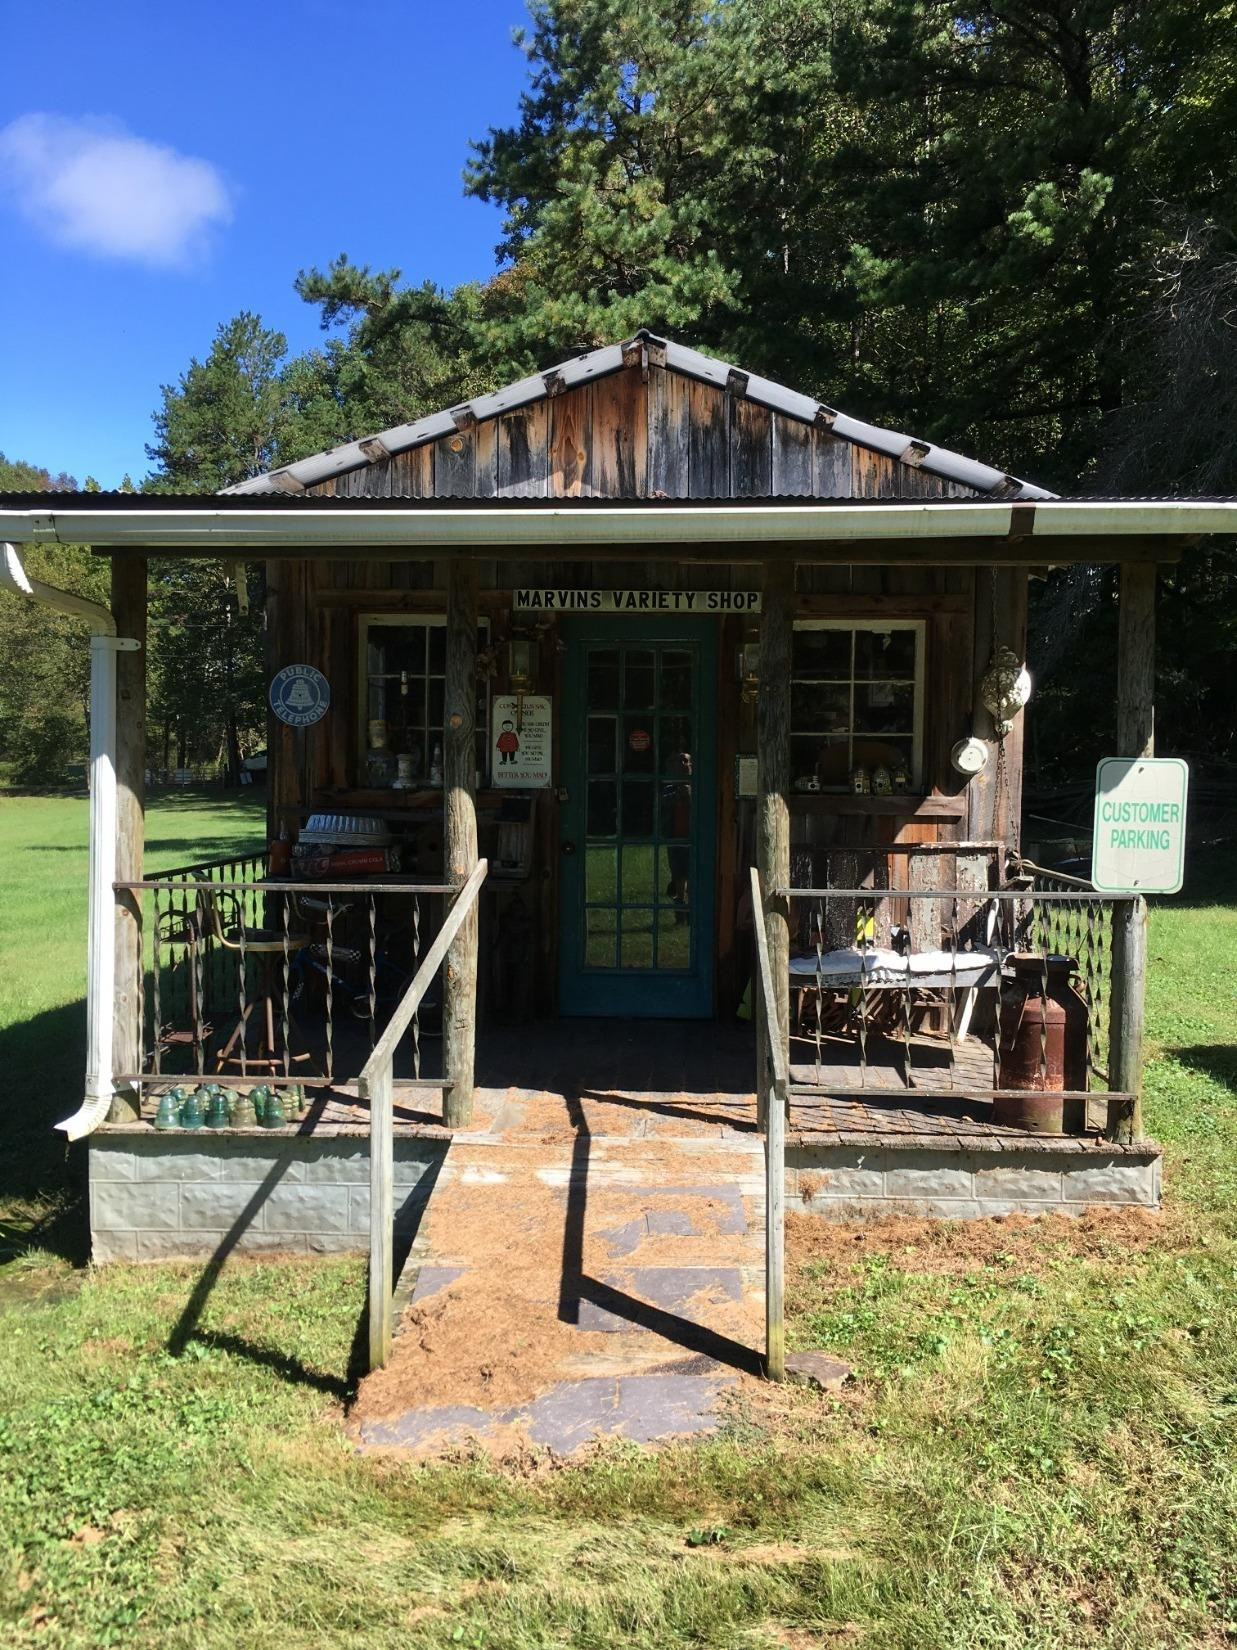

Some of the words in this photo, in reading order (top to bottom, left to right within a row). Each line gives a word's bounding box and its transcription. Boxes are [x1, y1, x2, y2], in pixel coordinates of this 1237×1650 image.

[516, 590, 602, 608] MARVINS
[611, 591, 696, 609] VARIETY
[707, 592, 758, 610] SHOP
[280, 667, 321, 682] PUBLIC
[273, 698, 328, 724] TELEPHONE
[1102, 802, 1180, 823] CUSTOMER
[1110, 829, 1171, 850] PARKING
